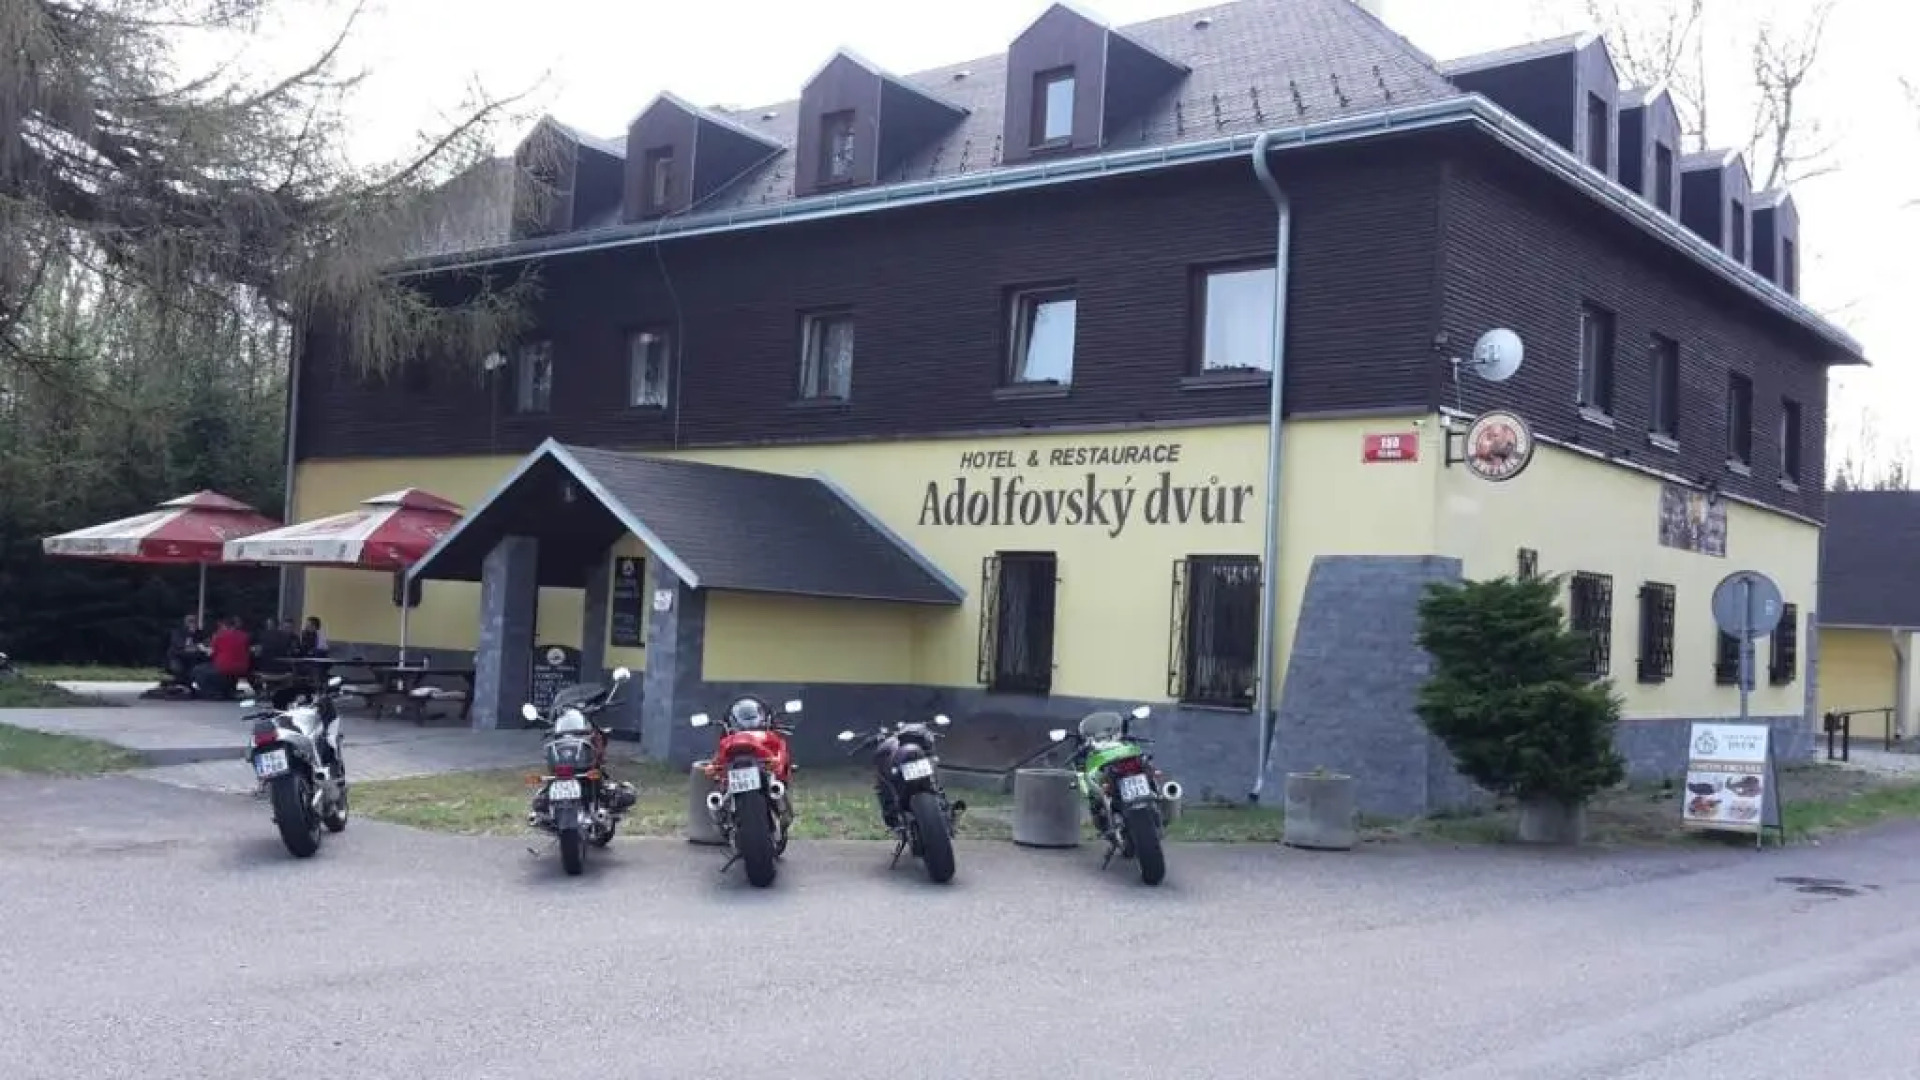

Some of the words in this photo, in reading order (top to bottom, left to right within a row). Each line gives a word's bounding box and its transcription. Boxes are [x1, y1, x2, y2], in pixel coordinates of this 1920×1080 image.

[960, 450, 1016, 469] HOTEL
[1027, 449, 1039, 468] &
[1050, 443, 1181, 467] RESTAURACE
[918, 473, 1136, 539] Adolfovský
[1144, 472, 1254, 525] dvůr
